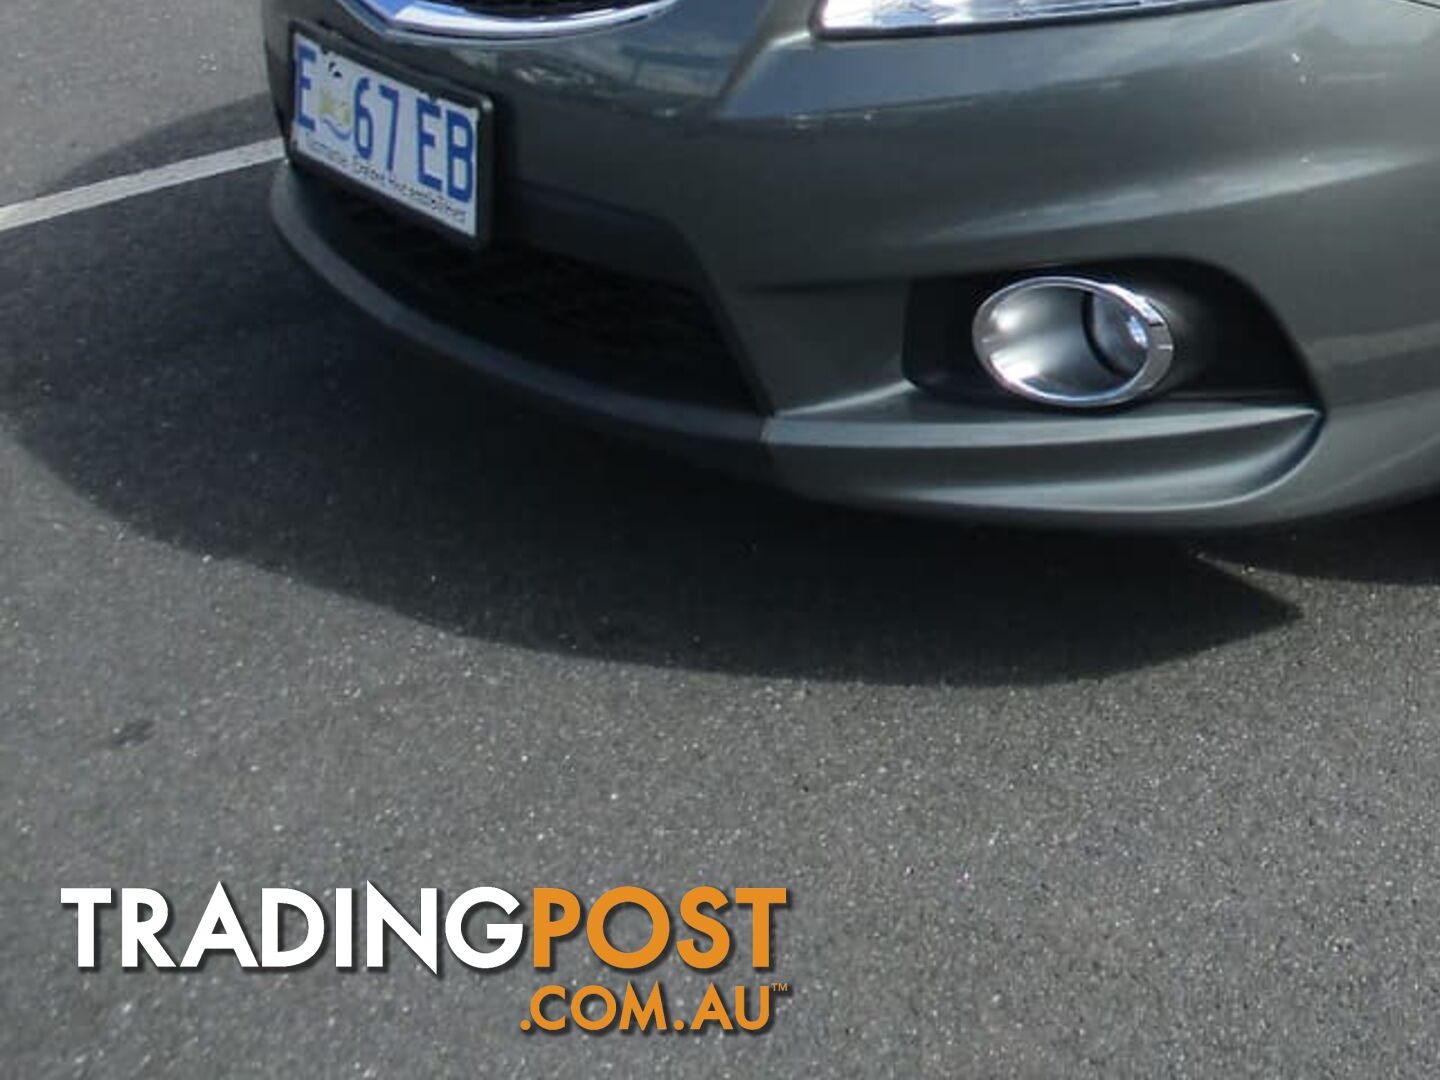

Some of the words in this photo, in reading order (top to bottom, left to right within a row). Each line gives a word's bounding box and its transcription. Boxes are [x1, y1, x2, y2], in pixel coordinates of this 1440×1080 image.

[297, 44, 317, 133] E
[354, 76, 399, 172] 67
[416, 96, 474, 204] EB
